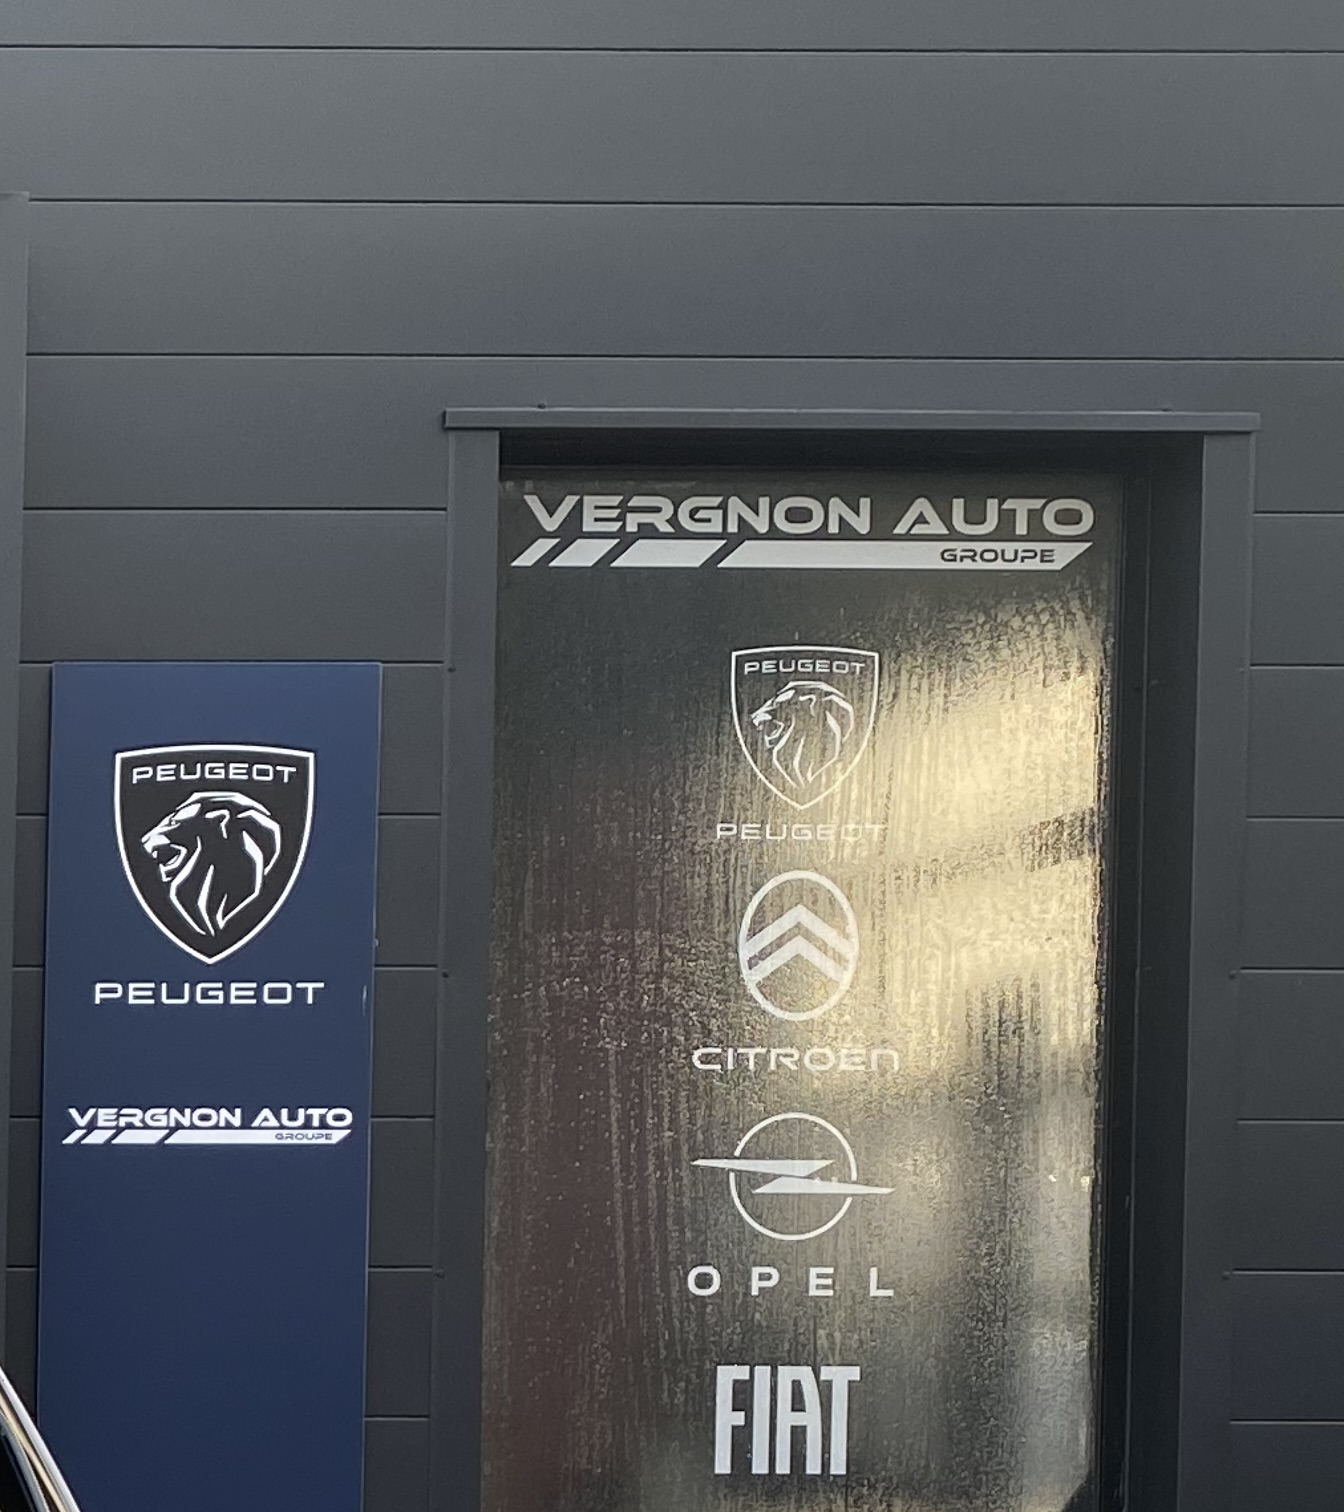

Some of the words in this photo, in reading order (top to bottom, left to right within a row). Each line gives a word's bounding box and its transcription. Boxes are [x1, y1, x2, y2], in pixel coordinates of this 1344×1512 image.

[523, 494, 871, 535] VERGNON
[892, 497, 1094, 536] AUTO
[939, 548, 1056, 564] GROUPE
[743, 659, 866, 675] PEUGEOT
[132, 762, 297, 784] PEUGEOT
[715, 822, 889, 841] PEUGEOT
[94, 982, 325, 1005] PEUGEOT
[68, 1107, 242, 1128] VERGNON
[250, 1107, 353, 1128] AUTO
[274, 1131, 333, 1141] GROUPE
[687, 1265, 895, 1297] OPEL
[714, 1364, 861, 1475] FIAT
